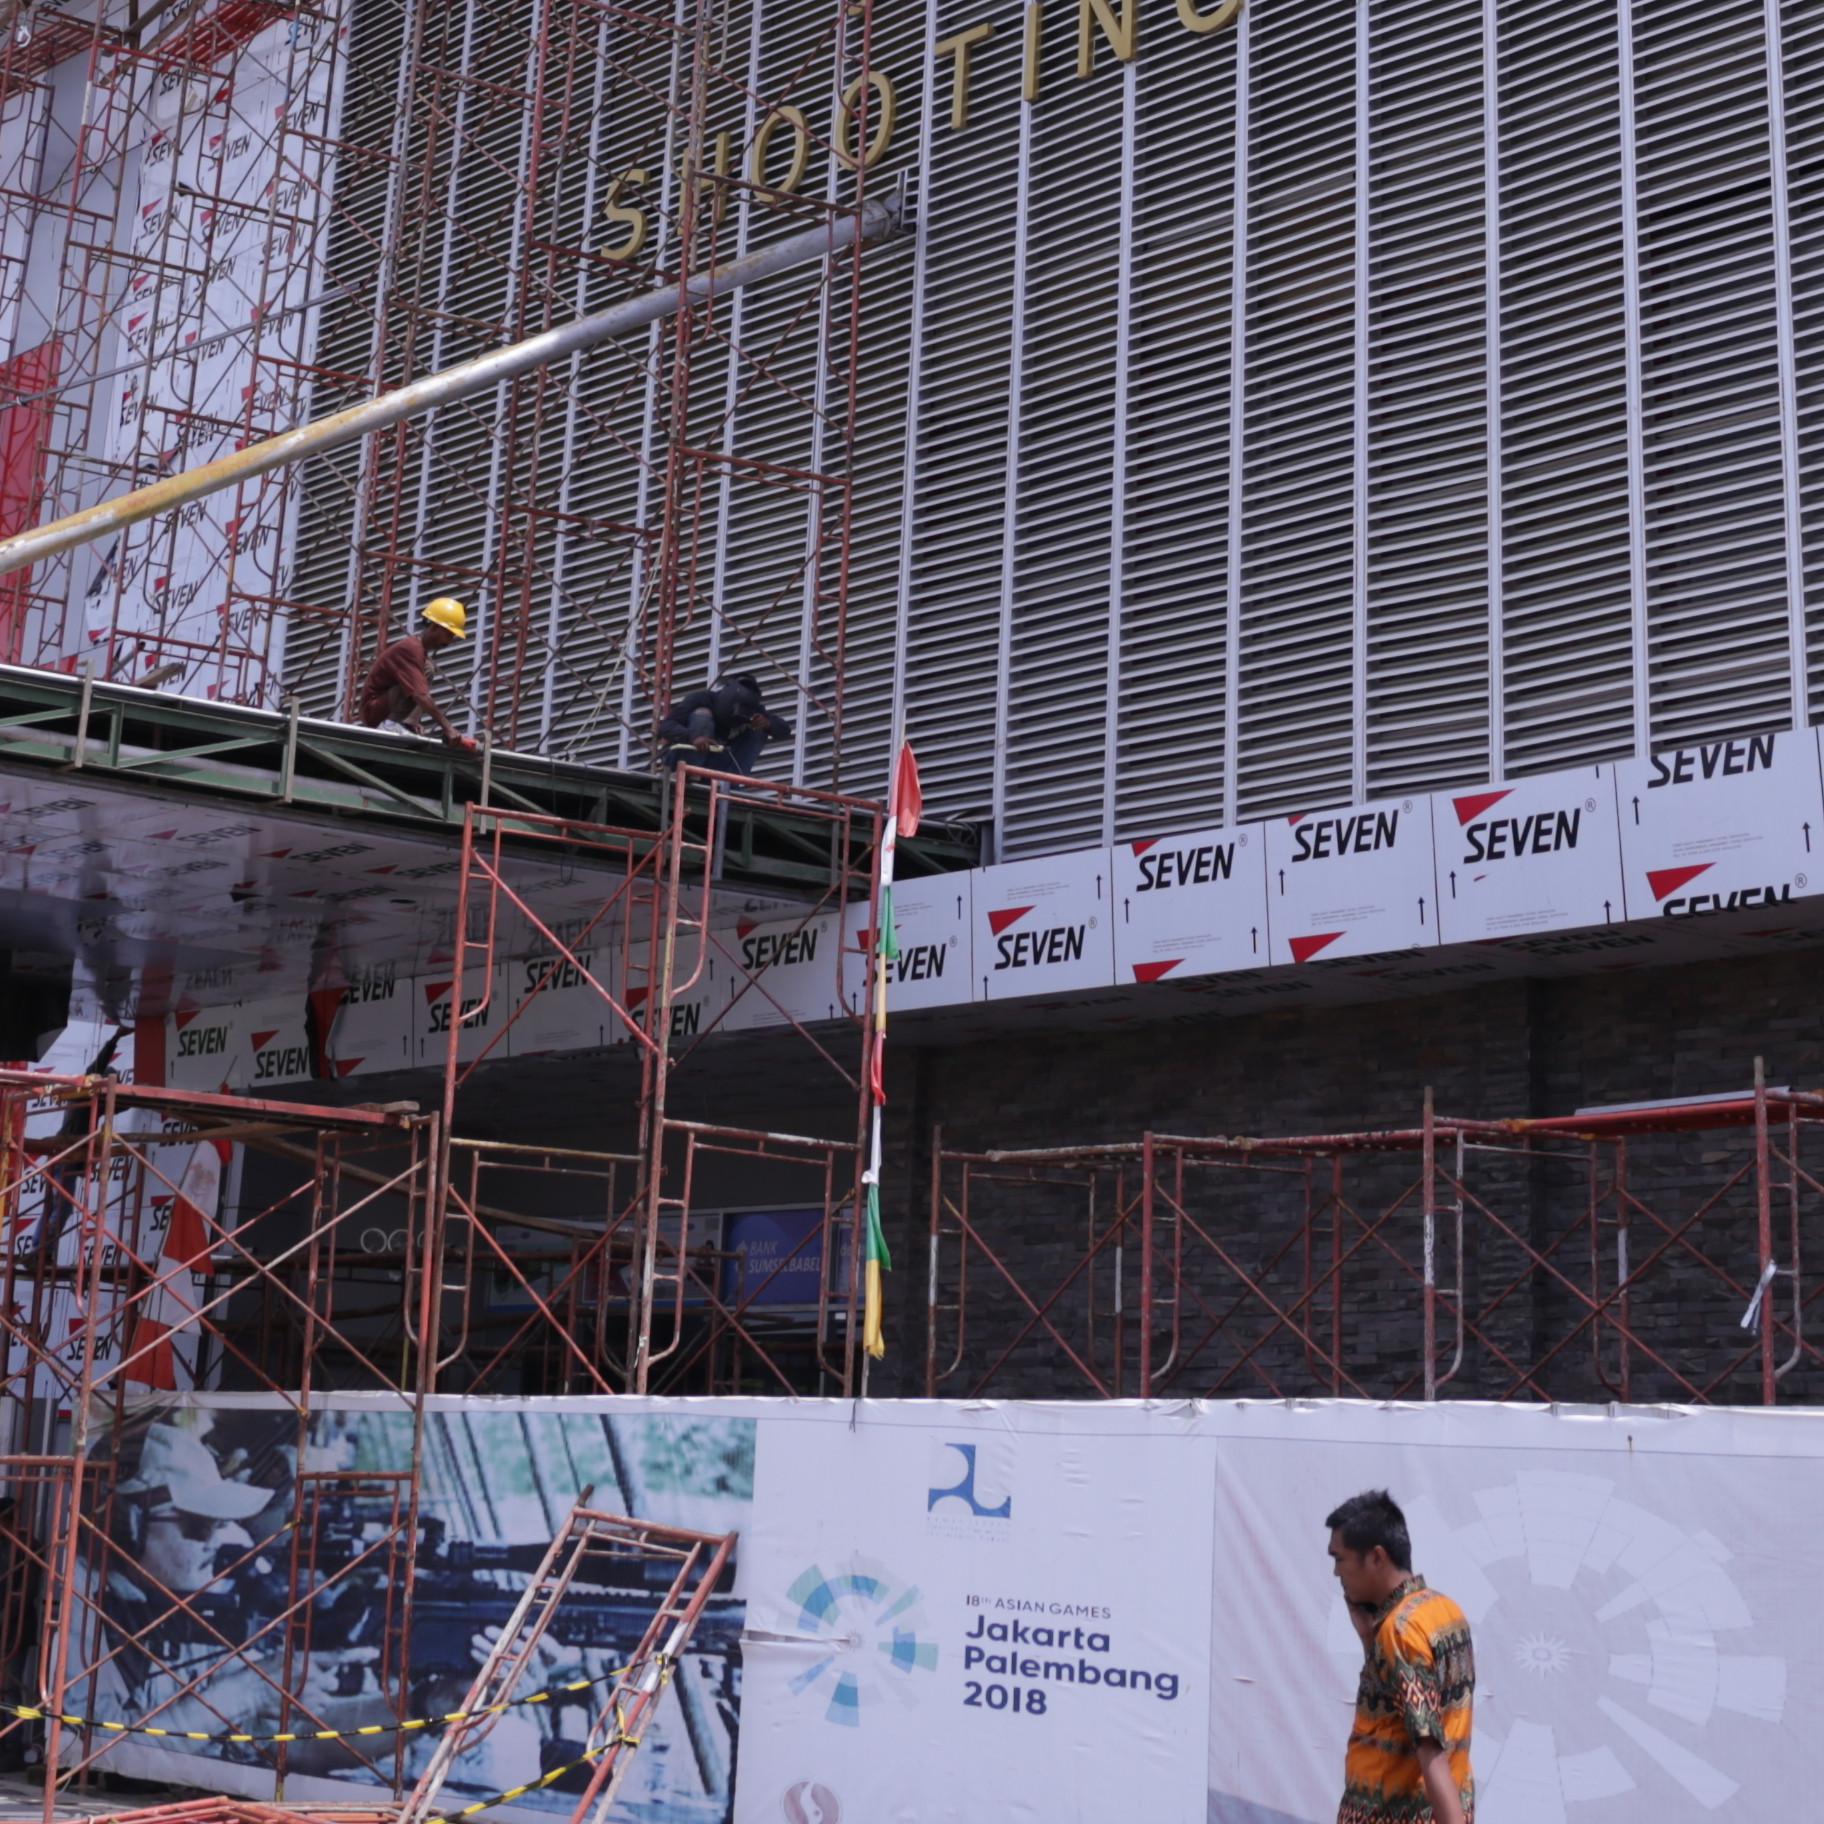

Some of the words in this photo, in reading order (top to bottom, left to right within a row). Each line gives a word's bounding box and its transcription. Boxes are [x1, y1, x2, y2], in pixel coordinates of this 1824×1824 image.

[1647, 735, 1775, 788] SEVEN
[291, 842, 372, 863] SEVEN
[1292, 809, 1399, 863] SEVEN
[1464, 808, 1580, 864] SEVEN
[1136, 843, 1234, 892] SEVEN
[743, 928, 817, 970] SEVEN
[994, 925, 1085, 970] SEVEN
[178, 1026, 228, 1057] SEVEN
[254, 1047, 311, 1079] SEVEN
[995, 1597, 1045, 1614] ASIAN
[1049, 1603, 1111, 1619] GAMES
[965, 1614, 1111, 1653] Jakarta
[964, 1645, 1179, 1701] Palembang
[963, 1680, 1047, 1716] 2018
